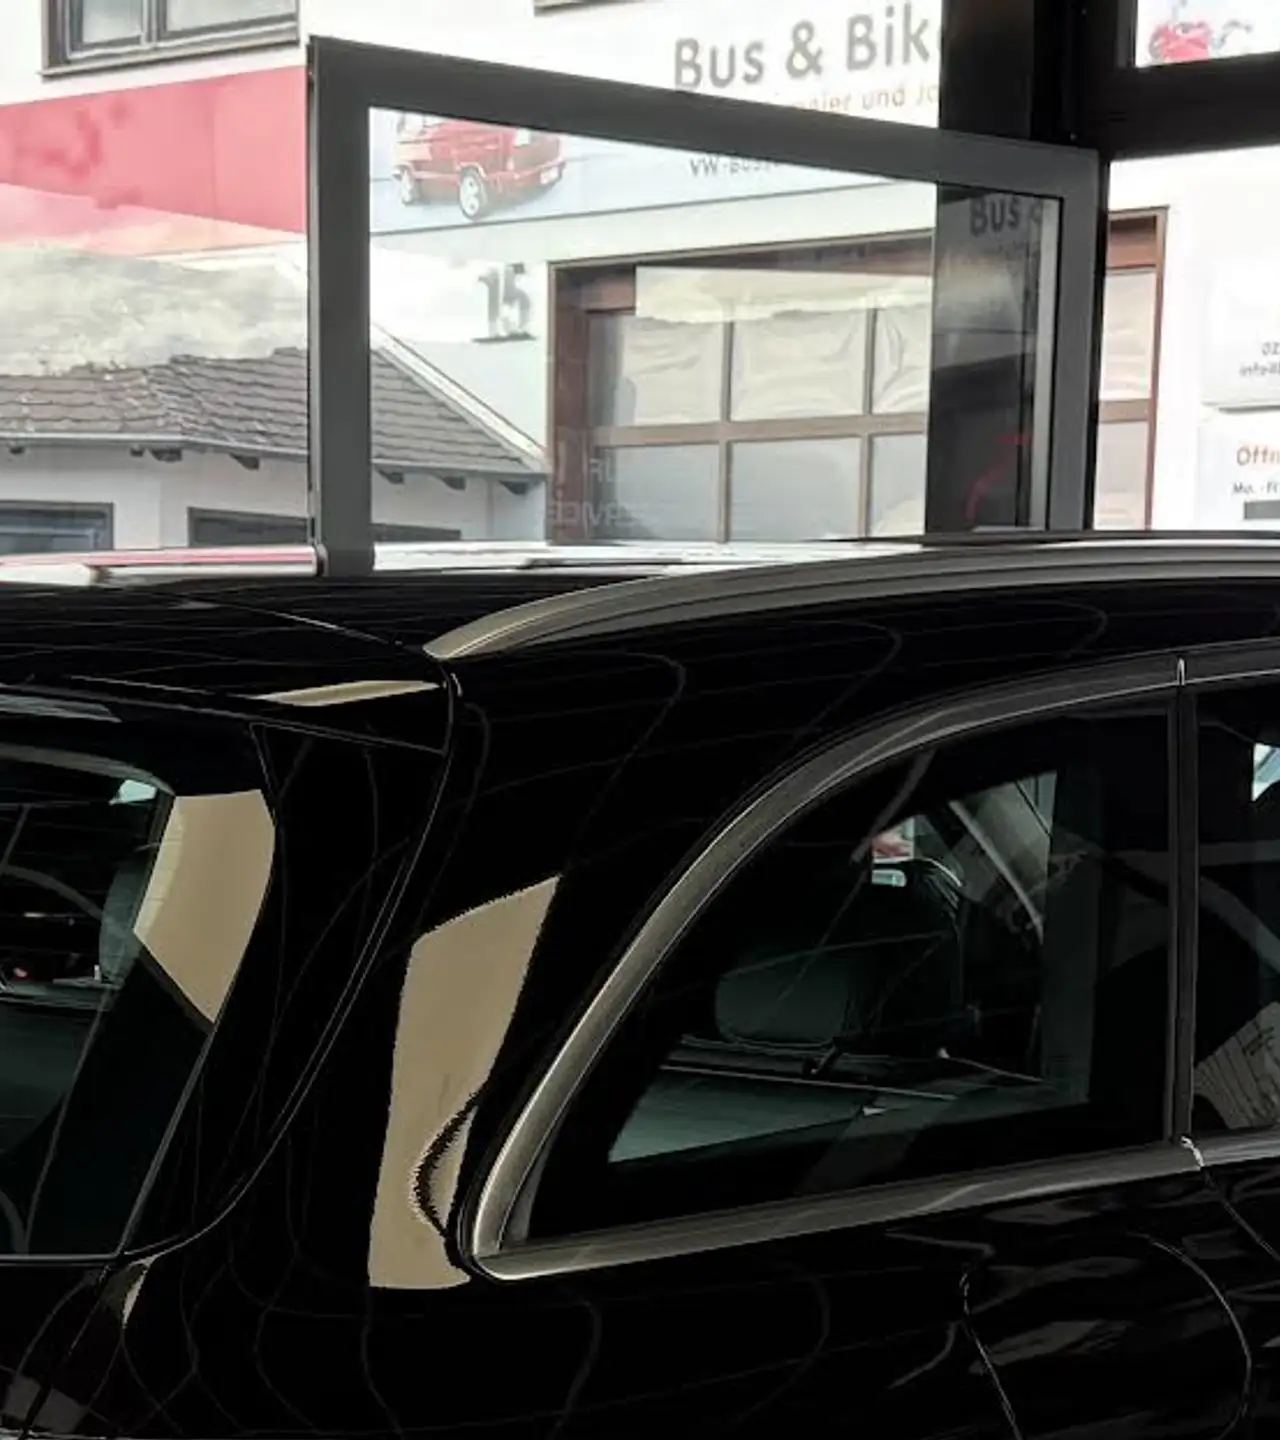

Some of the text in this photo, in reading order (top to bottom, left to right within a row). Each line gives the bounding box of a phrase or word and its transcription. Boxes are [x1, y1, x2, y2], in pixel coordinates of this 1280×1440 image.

[674, 1, 940, 90] Bus & Bik
[477, 263, 532, 340] 15
